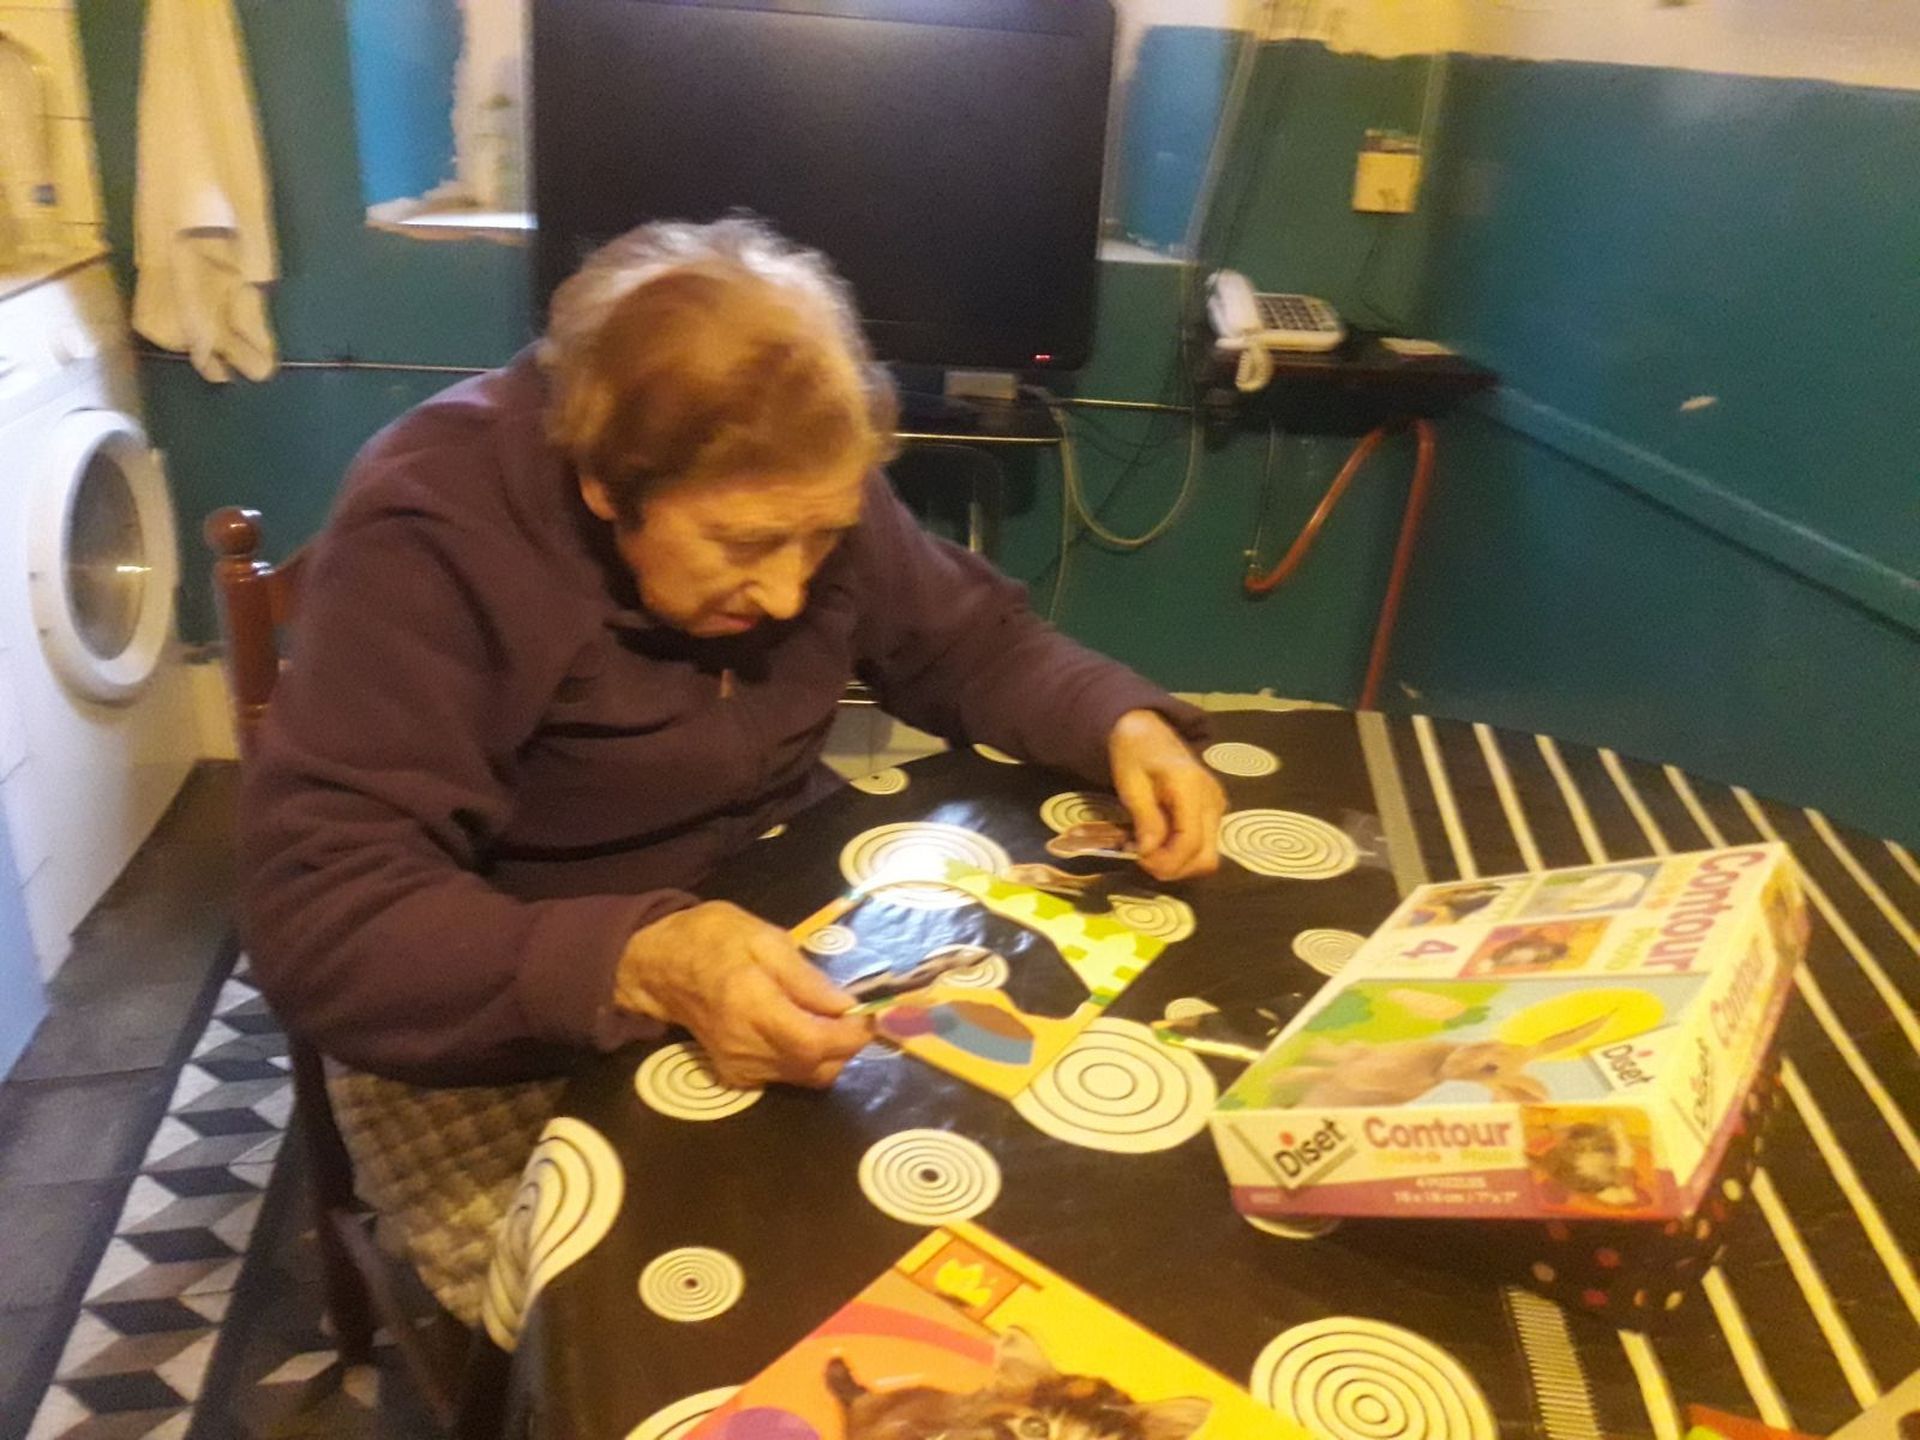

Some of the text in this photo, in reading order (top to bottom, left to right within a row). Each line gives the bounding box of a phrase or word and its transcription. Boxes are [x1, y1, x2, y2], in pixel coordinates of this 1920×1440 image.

[1642, 851, 1767, 971] Contour
[1601, 1043, 1655, 1086] Diset
[1273, 1117, 1345, 1178] Diset
[1363, 1115, 1513, 1150] Contour
